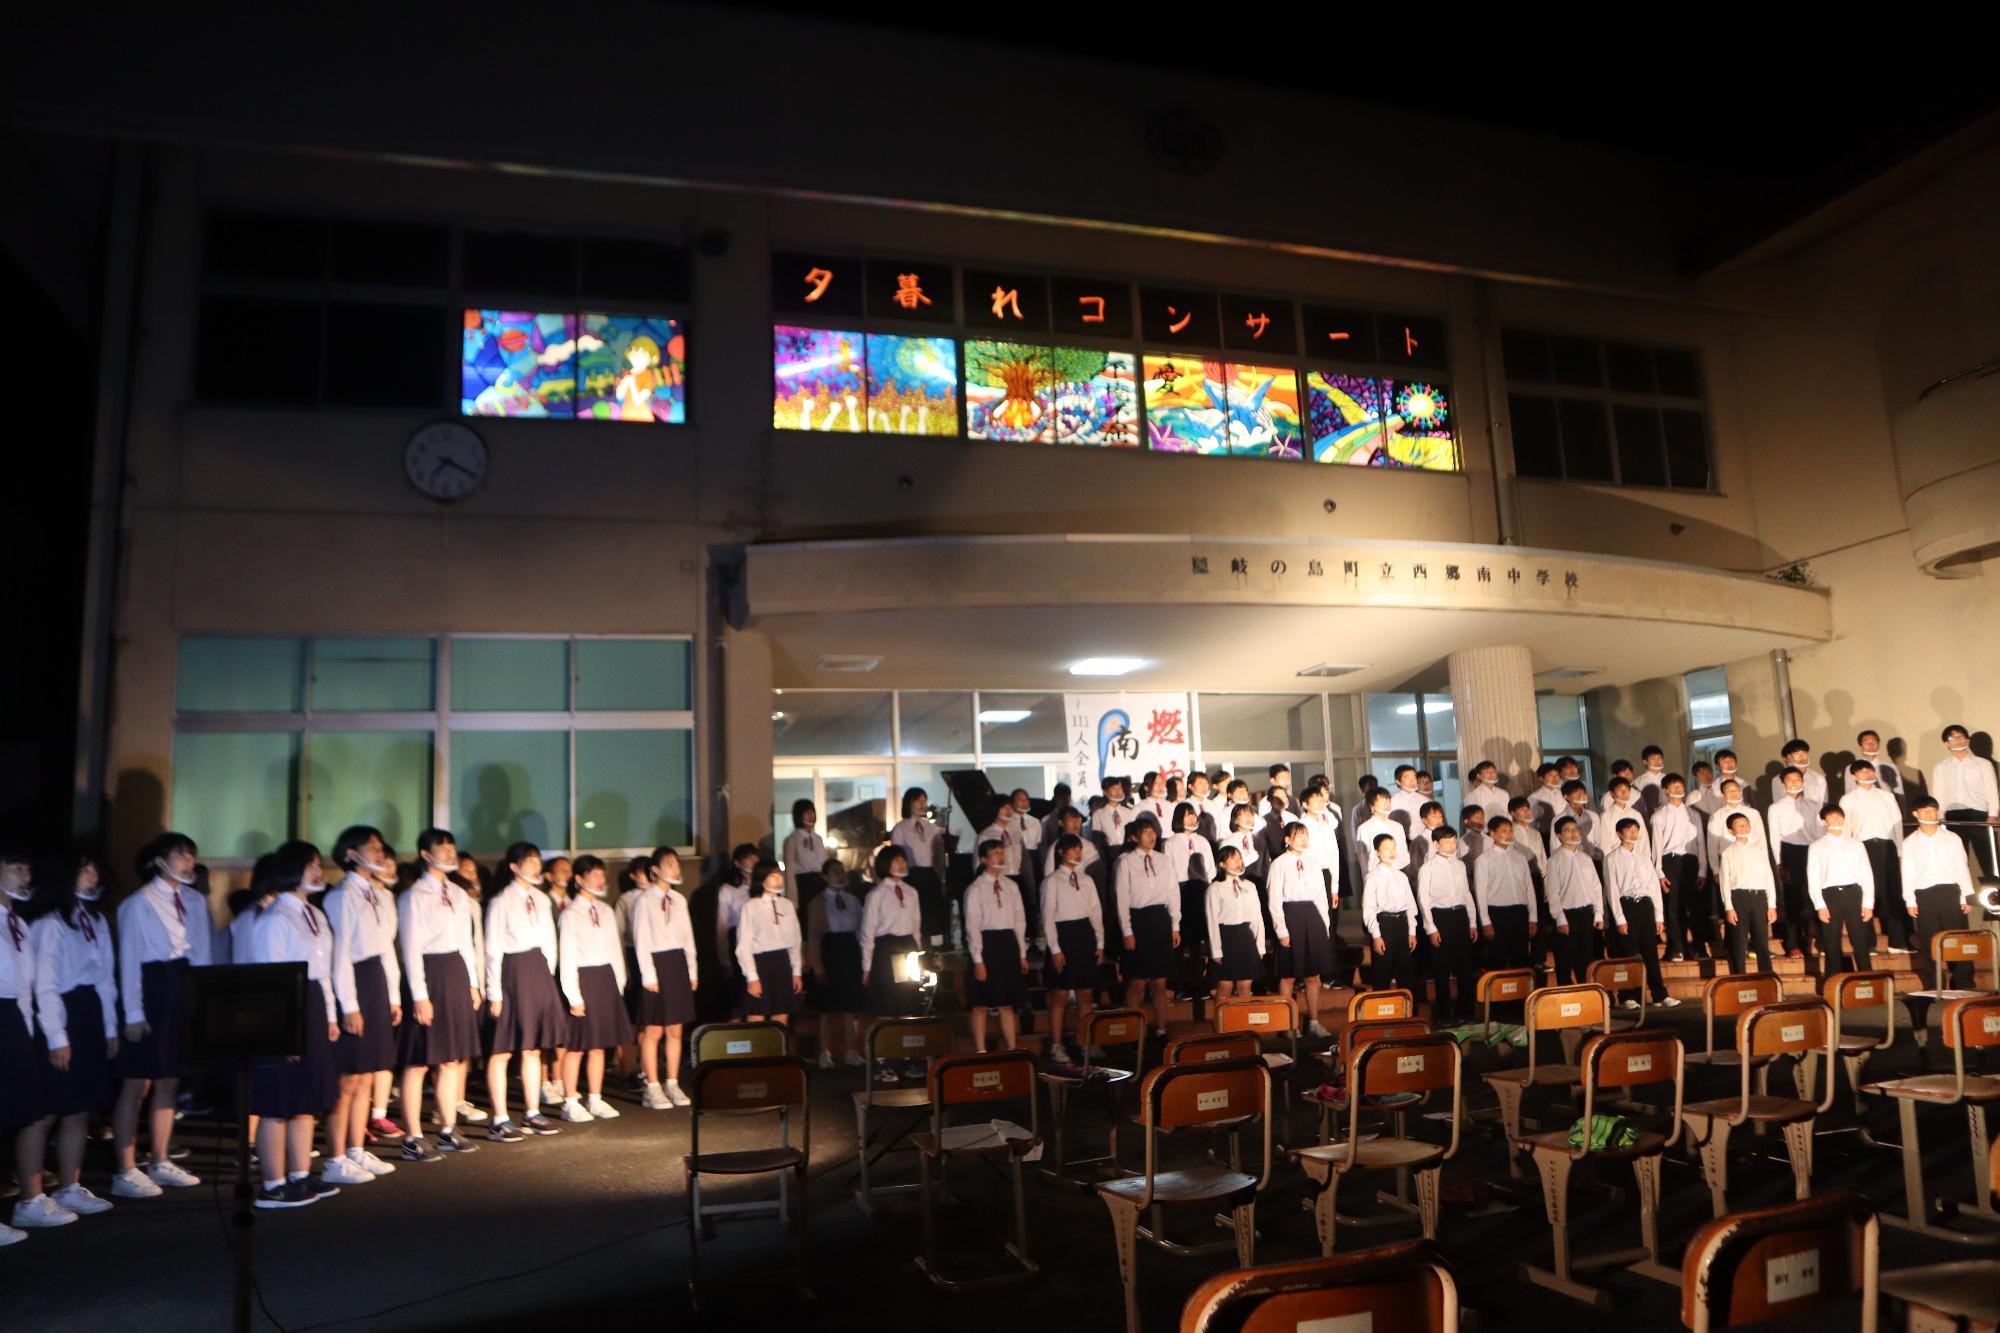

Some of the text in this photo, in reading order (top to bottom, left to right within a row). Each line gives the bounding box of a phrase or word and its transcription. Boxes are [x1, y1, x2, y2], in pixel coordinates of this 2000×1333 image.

[804, 267, 1418, 356] 夕暮れコンサート
[1112, 724, 1139, 760] 南
